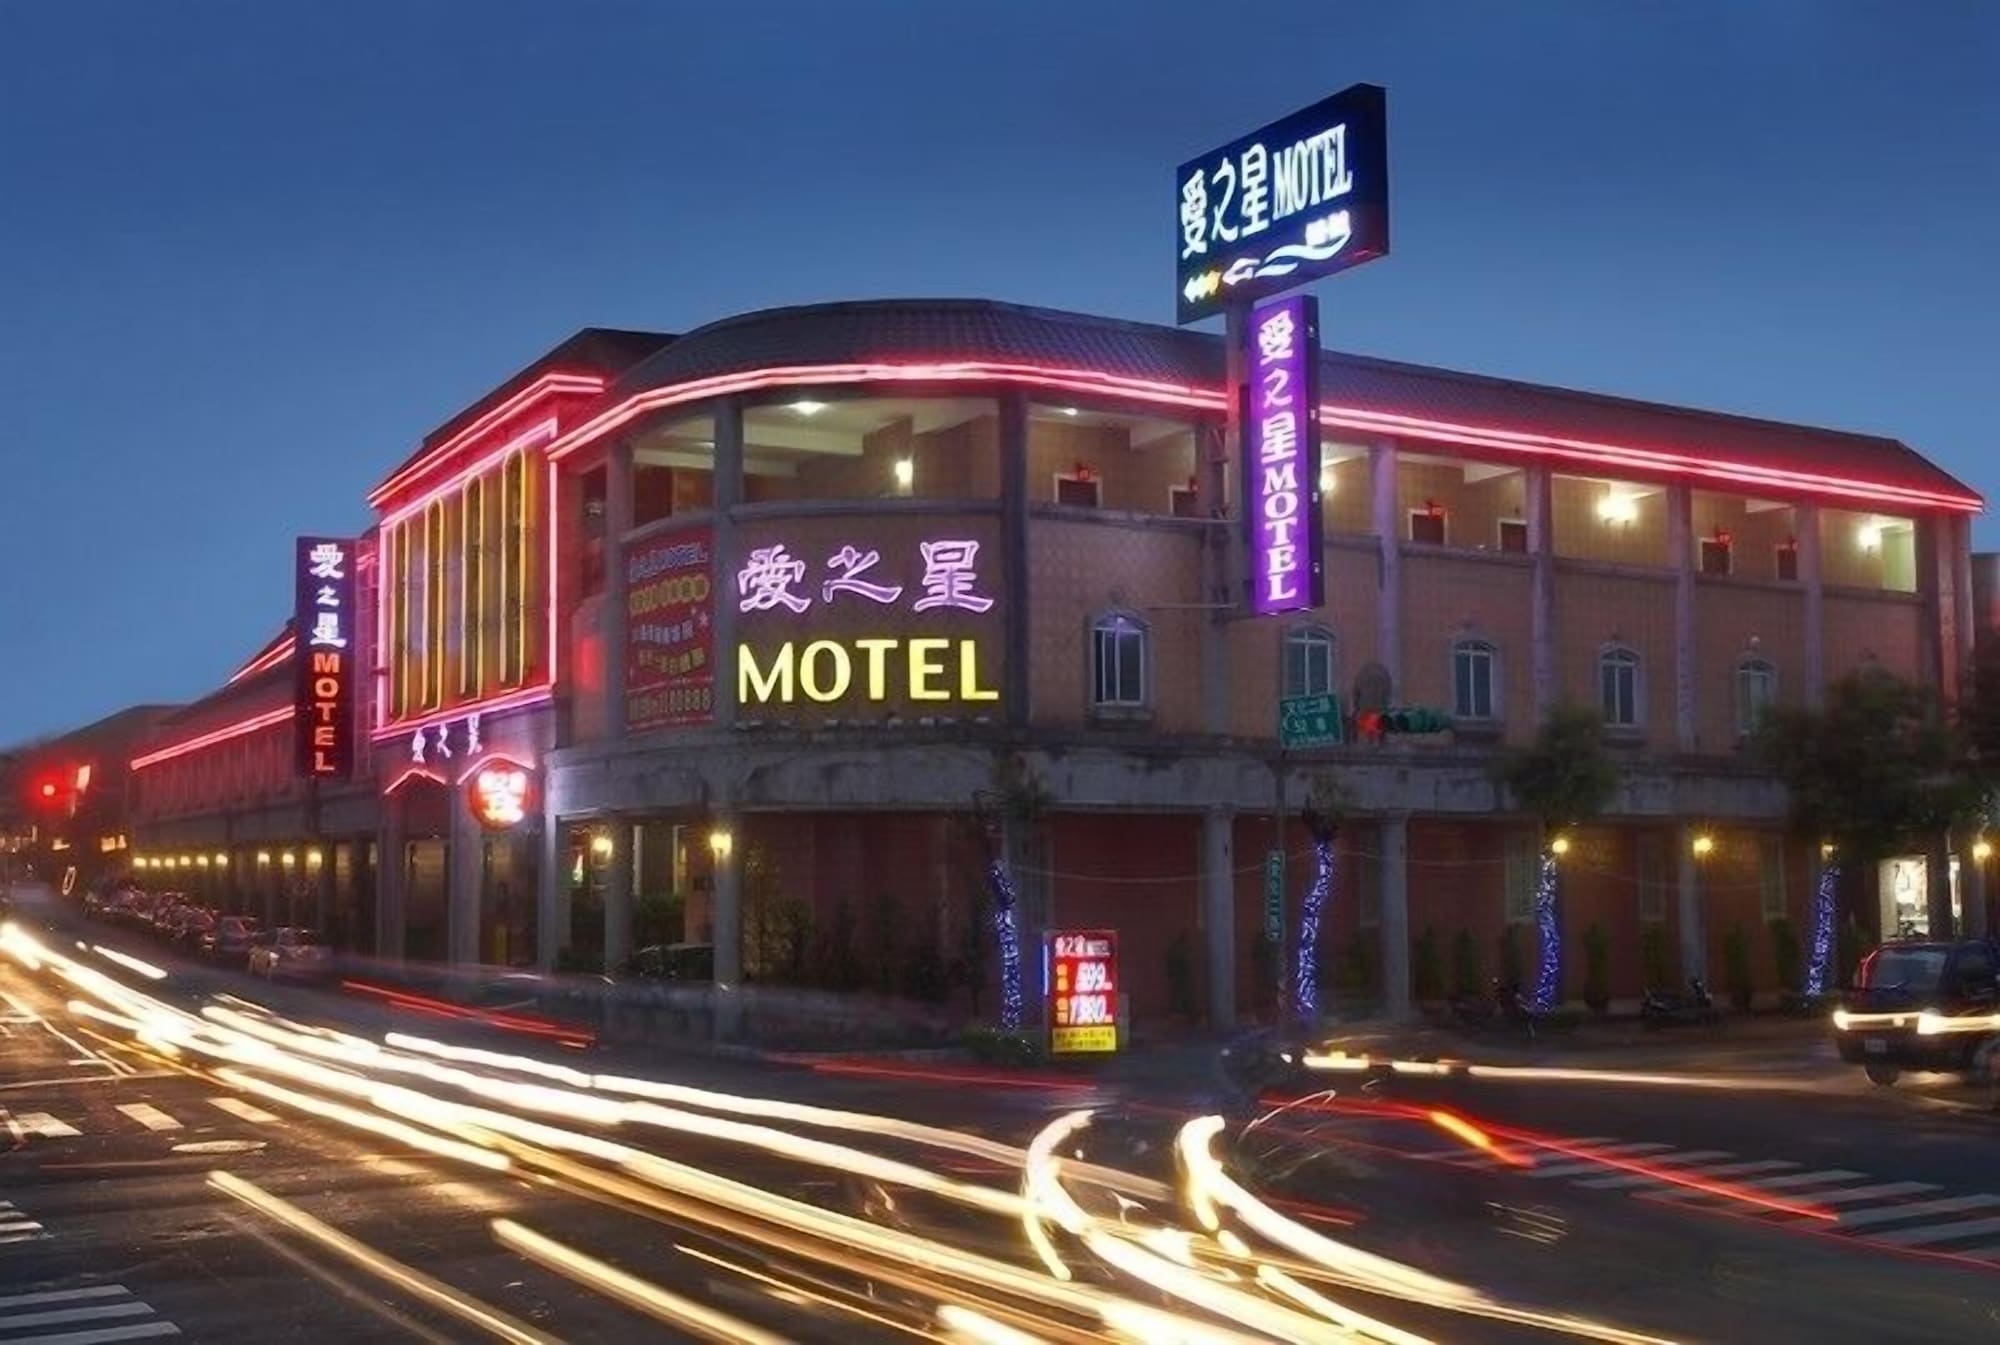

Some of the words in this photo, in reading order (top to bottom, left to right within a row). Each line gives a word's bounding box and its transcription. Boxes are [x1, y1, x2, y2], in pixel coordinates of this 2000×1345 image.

[1181, 143, 1270, 260] 愛之星
[1273, 123, 1352, 221] MOTEL
[1258, 310, 1298, 464] 愛之星
[737, 540, 994, 613] 愛之星
[1262, 462, 1298, 602] MOTEL
[309, 543, 347, 648] 愛之星
[313, 652, 340, 772] MOTEL
[738, 639, 999, 702] MOTEL
